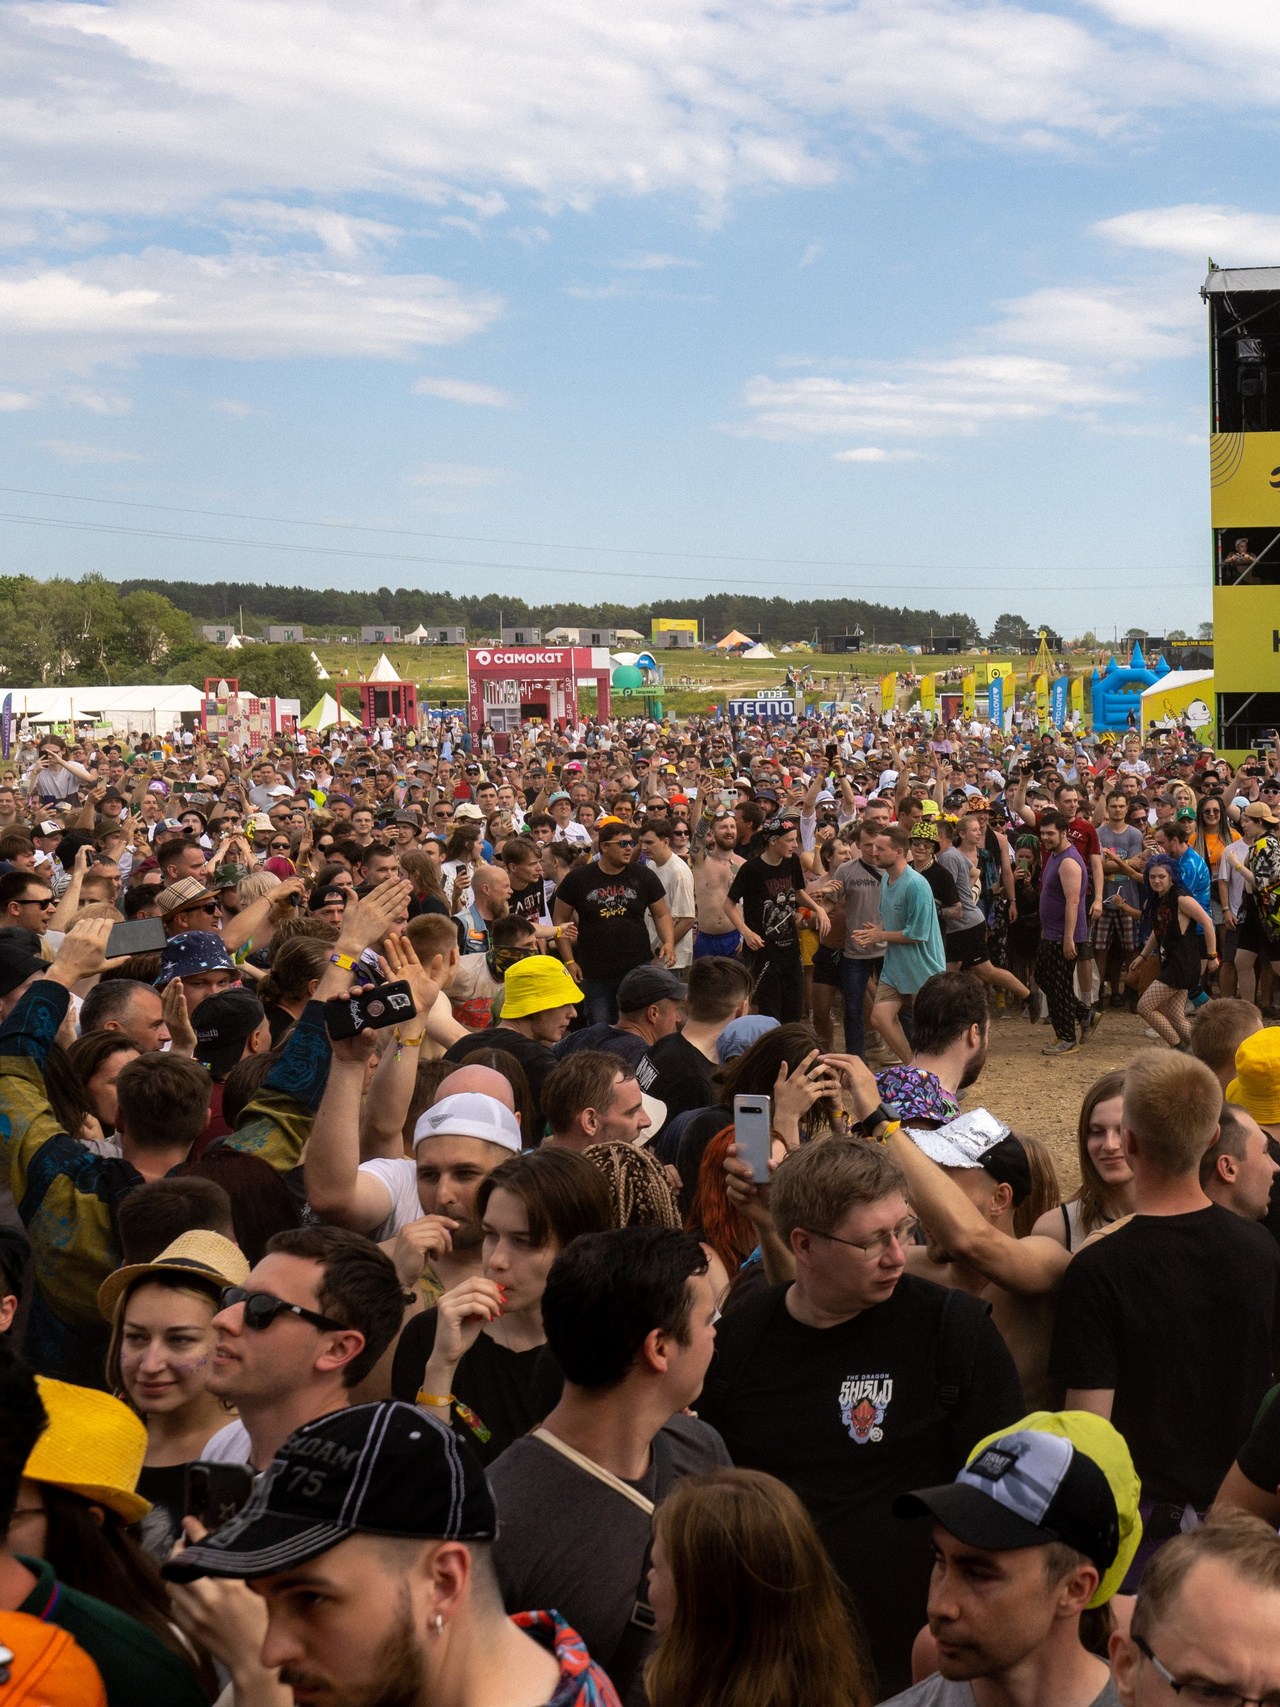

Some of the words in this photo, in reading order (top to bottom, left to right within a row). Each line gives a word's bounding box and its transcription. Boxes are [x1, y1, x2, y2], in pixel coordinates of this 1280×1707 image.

[471, 706, 479, 721] БАР
[730, 701, 793, 716] TECNO
[472, 733, 480, 748] БАР
[600, 907, 627, 918] Spirit
[838, 1379, 893, 1406] SHIELD
